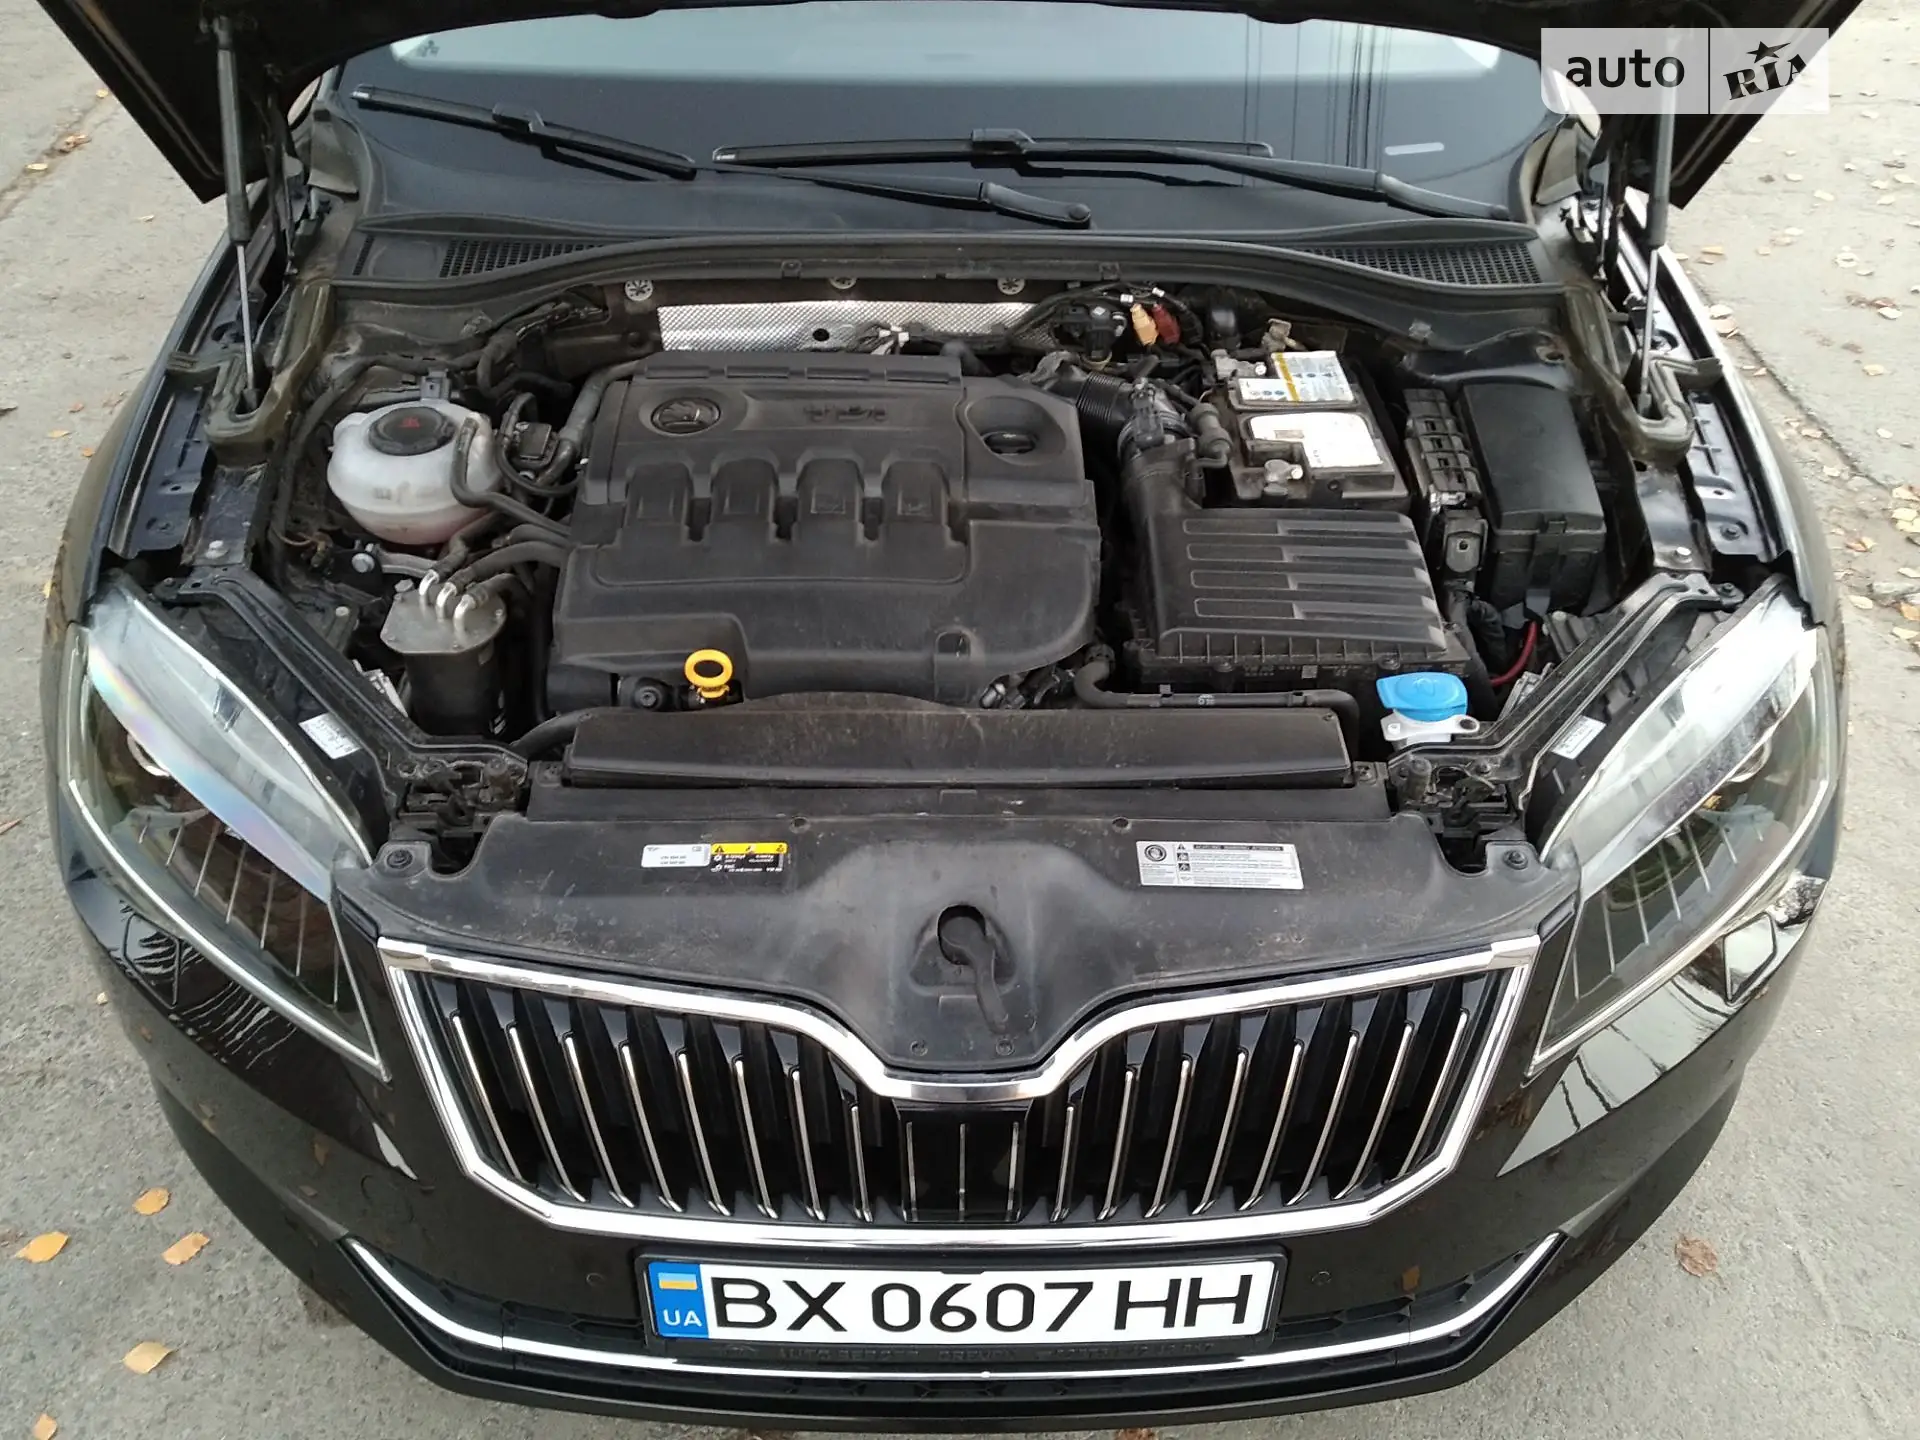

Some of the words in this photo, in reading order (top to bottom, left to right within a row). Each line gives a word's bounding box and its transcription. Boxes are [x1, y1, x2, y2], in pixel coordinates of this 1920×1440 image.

[663, 1308, 702, 1327] UA
[711, 1277, 847, 1332] BX
[872, 1282, 1093, 1332] 0607
[1114, 1274, 1253, 1330] HH
